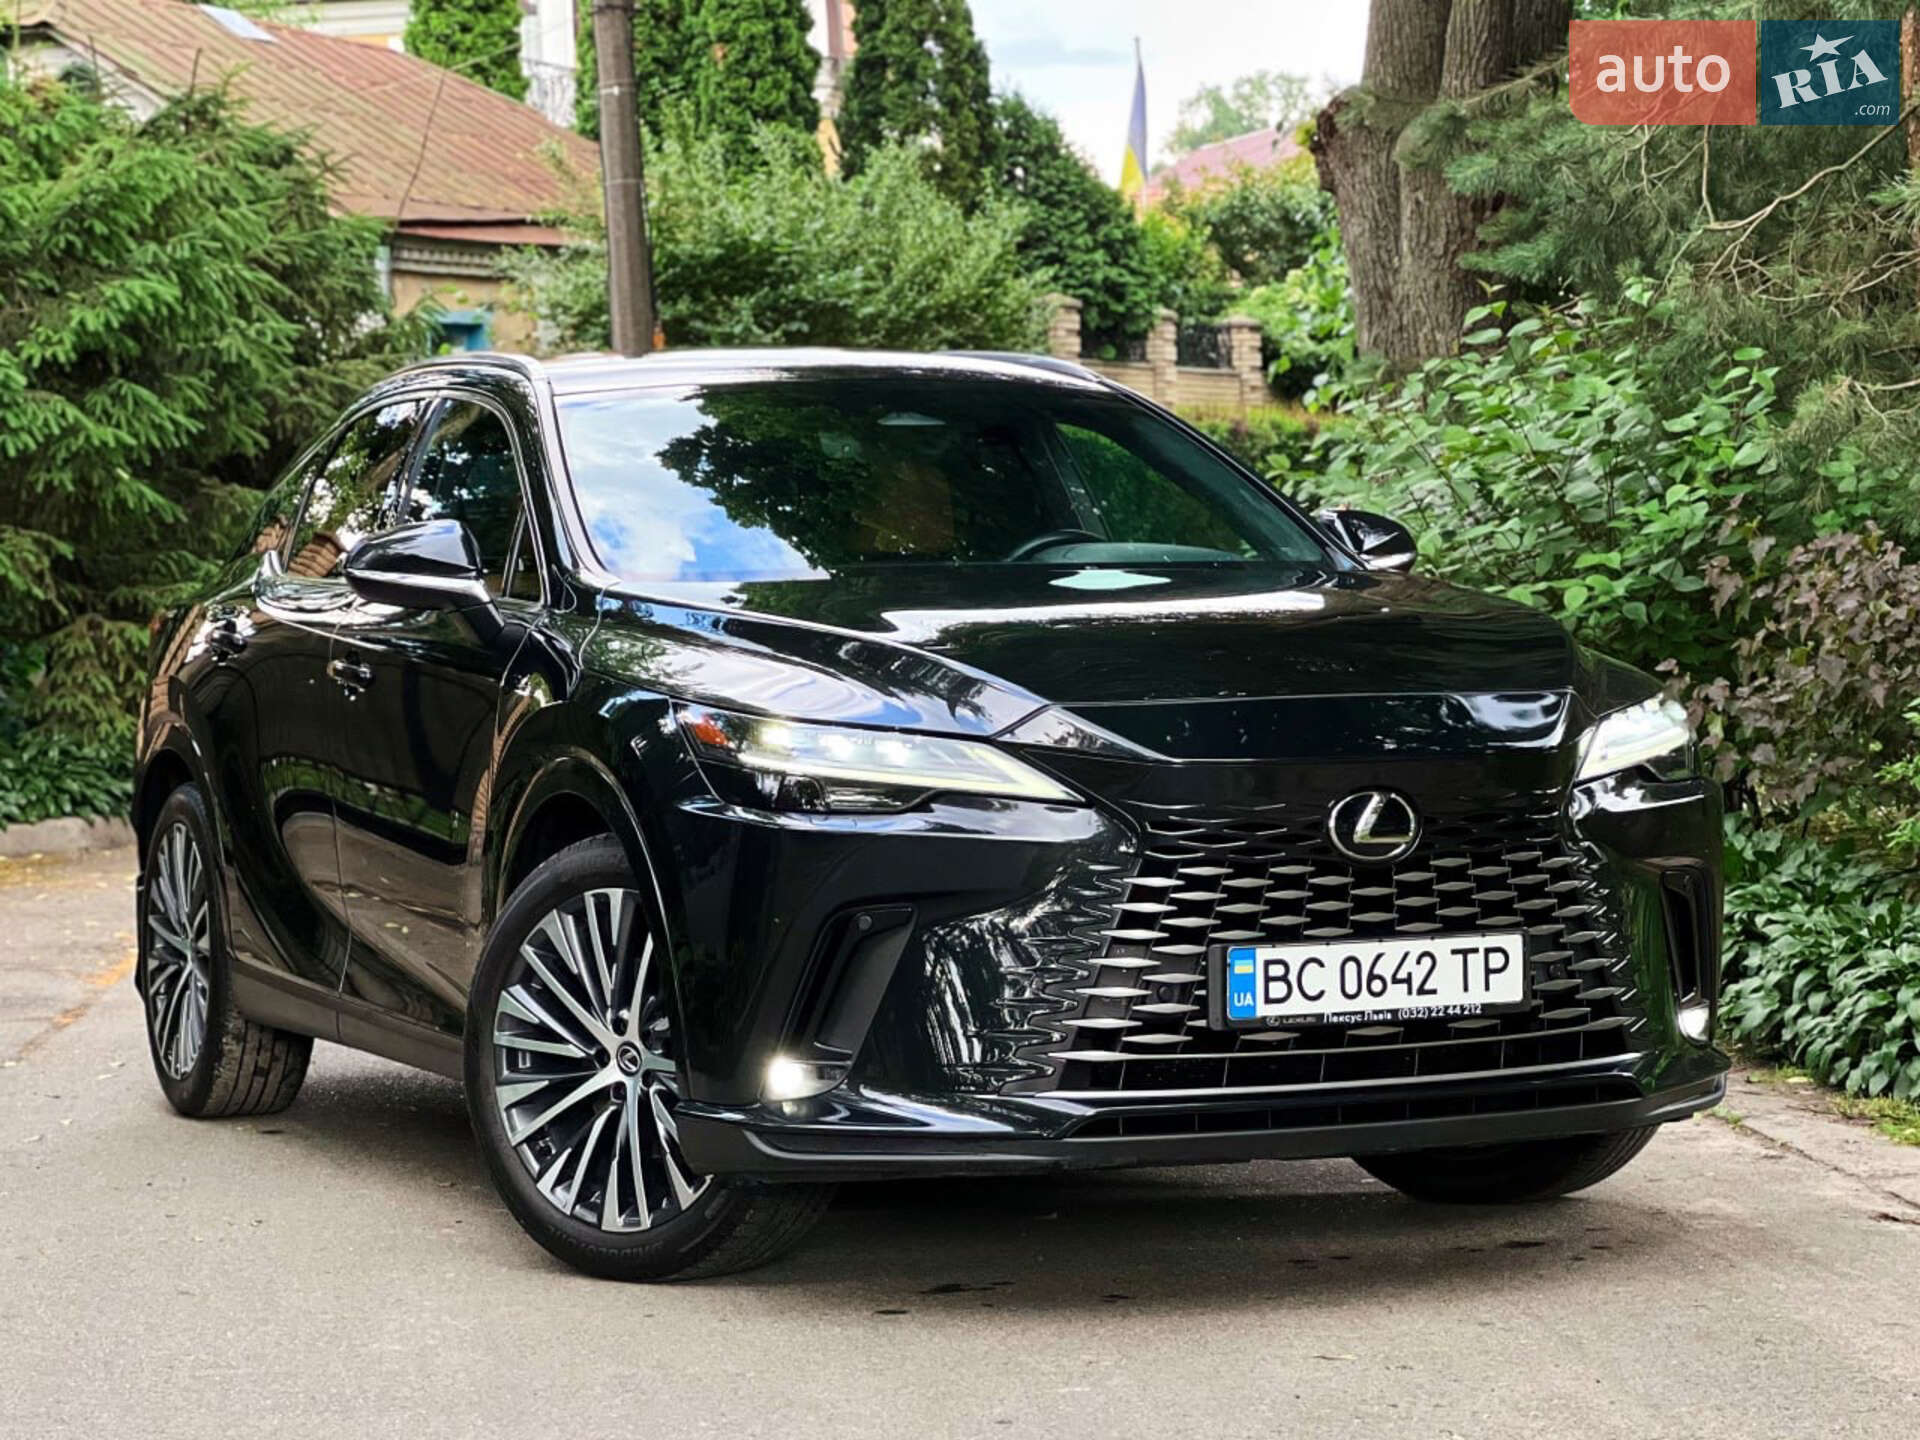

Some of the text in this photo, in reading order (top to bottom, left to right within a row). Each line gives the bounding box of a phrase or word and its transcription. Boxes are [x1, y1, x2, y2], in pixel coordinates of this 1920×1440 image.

[1263, 946, 1511, 1004] BC 0642 TP
[1234, 993, 1255, 1007] UA
[1398, 1006, 1429, 1020] (032)
[1431, 1005, 1445, 1017] 22
[1447, 1004, 1462, 1016] 44
[1463, 1002, 1483, 1015] 212
